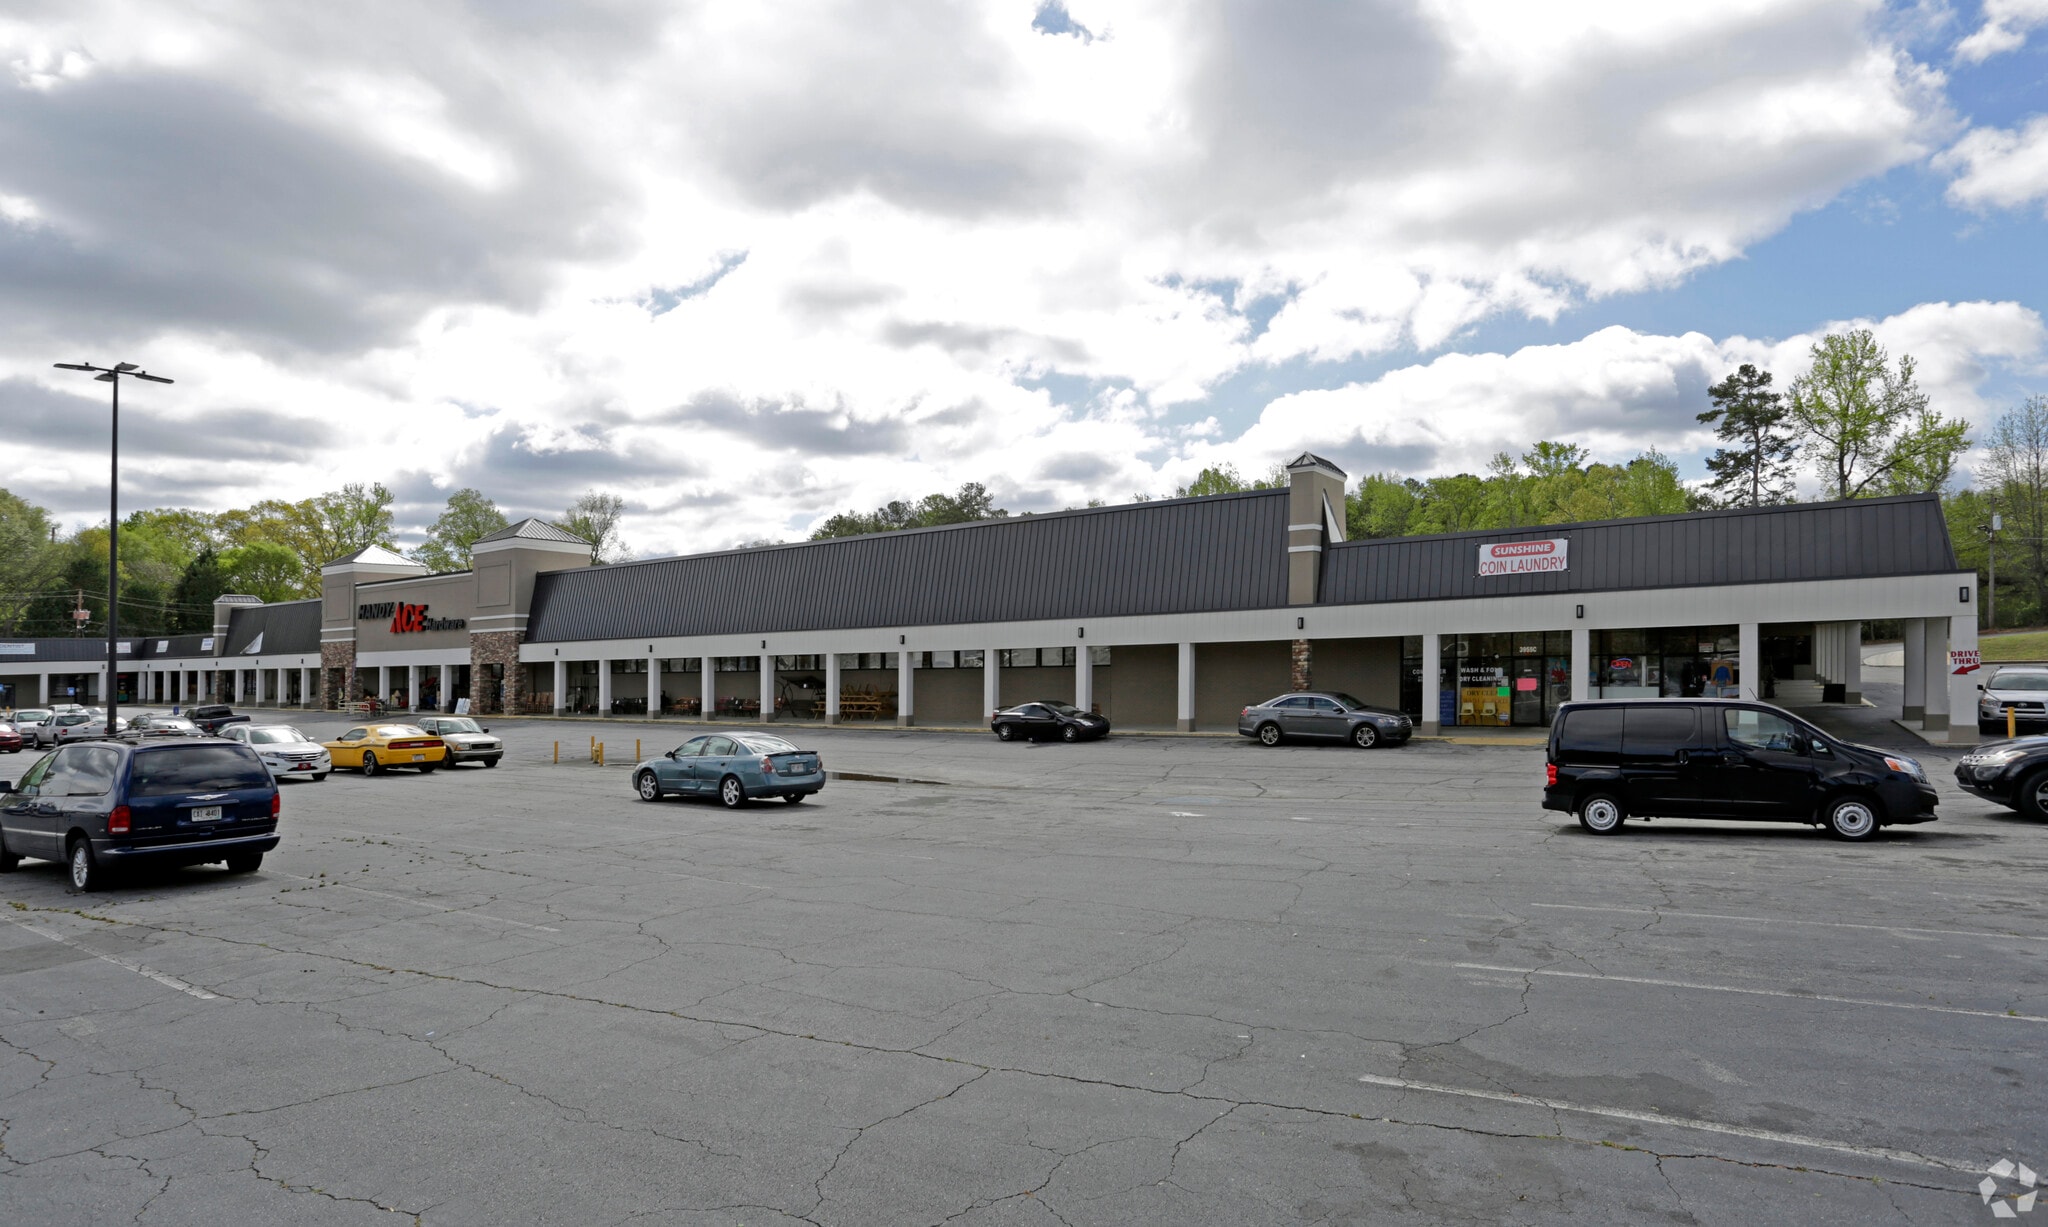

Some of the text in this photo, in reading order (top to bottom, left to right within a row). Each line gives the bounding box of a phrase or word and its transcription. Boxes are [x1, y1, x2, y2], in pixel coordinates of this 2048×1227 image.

[1494, 543, 1551, 556] SUNSHINE
[1480, 556, 1566, 574] COIN LAUNDRY
[358, 602, 466, 632] HANDY ACE Hardware
[1950, 650, 1981, 658] DRIVE
[1611, 659, 1632, 669] OPEN
